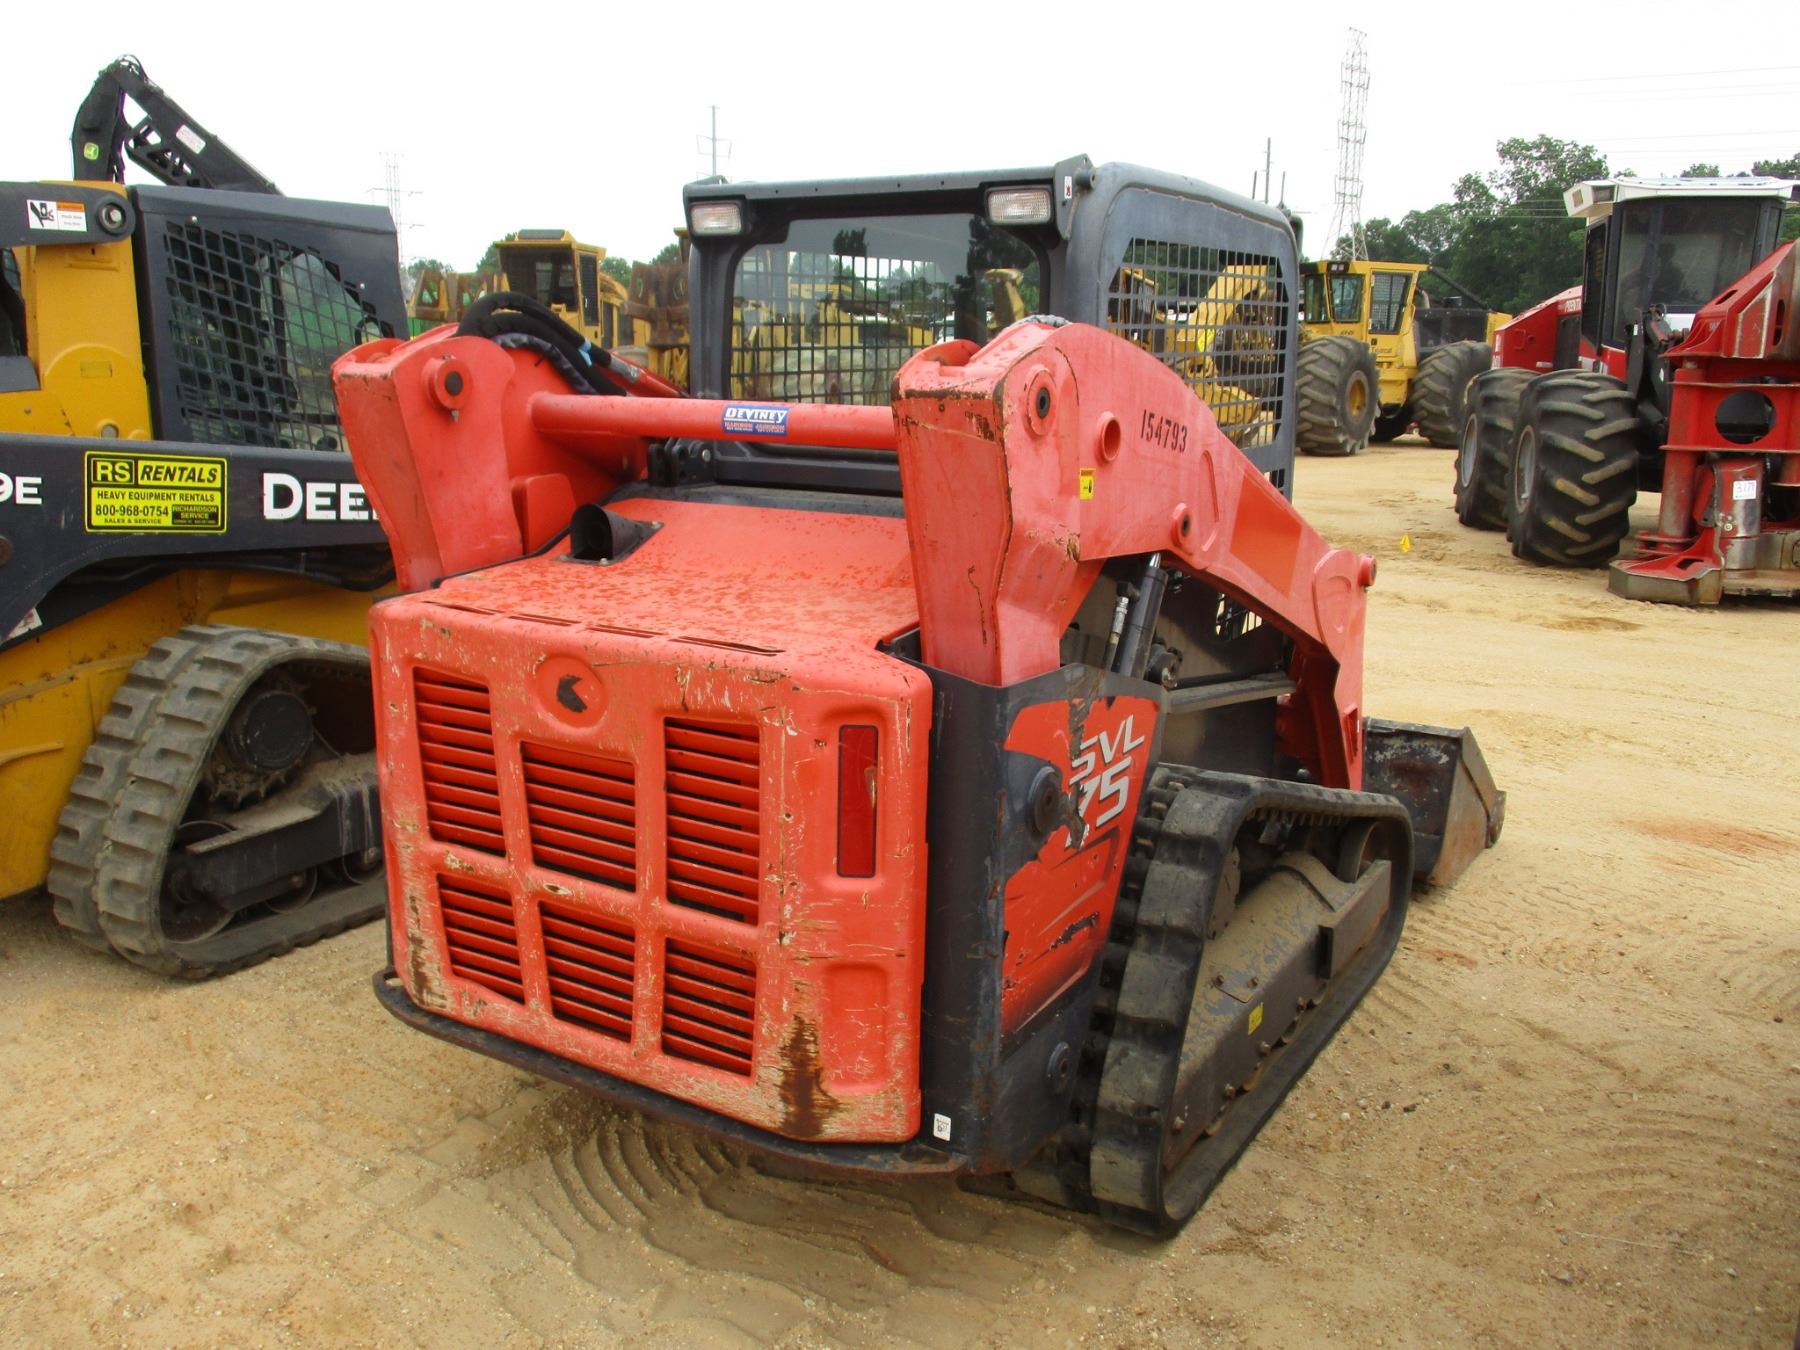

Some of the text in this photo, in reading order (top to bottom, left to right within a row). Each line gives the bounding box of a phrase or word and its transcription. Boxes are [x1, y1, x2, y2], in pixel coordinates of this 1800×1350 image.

[725, 407, 788, 424] DEVINEY
[1141, 409, 1188, 453] 154793
[96, 461, 218, 484] RS RENTALS
[97, 490, 215, 502] HEAVY EQUIPMENT RENTALS
[263, 472, 379, 520] DEE
[95, 504, 169, 517] 800-968-0754
[1069, 714, 1145, 785] SVL
